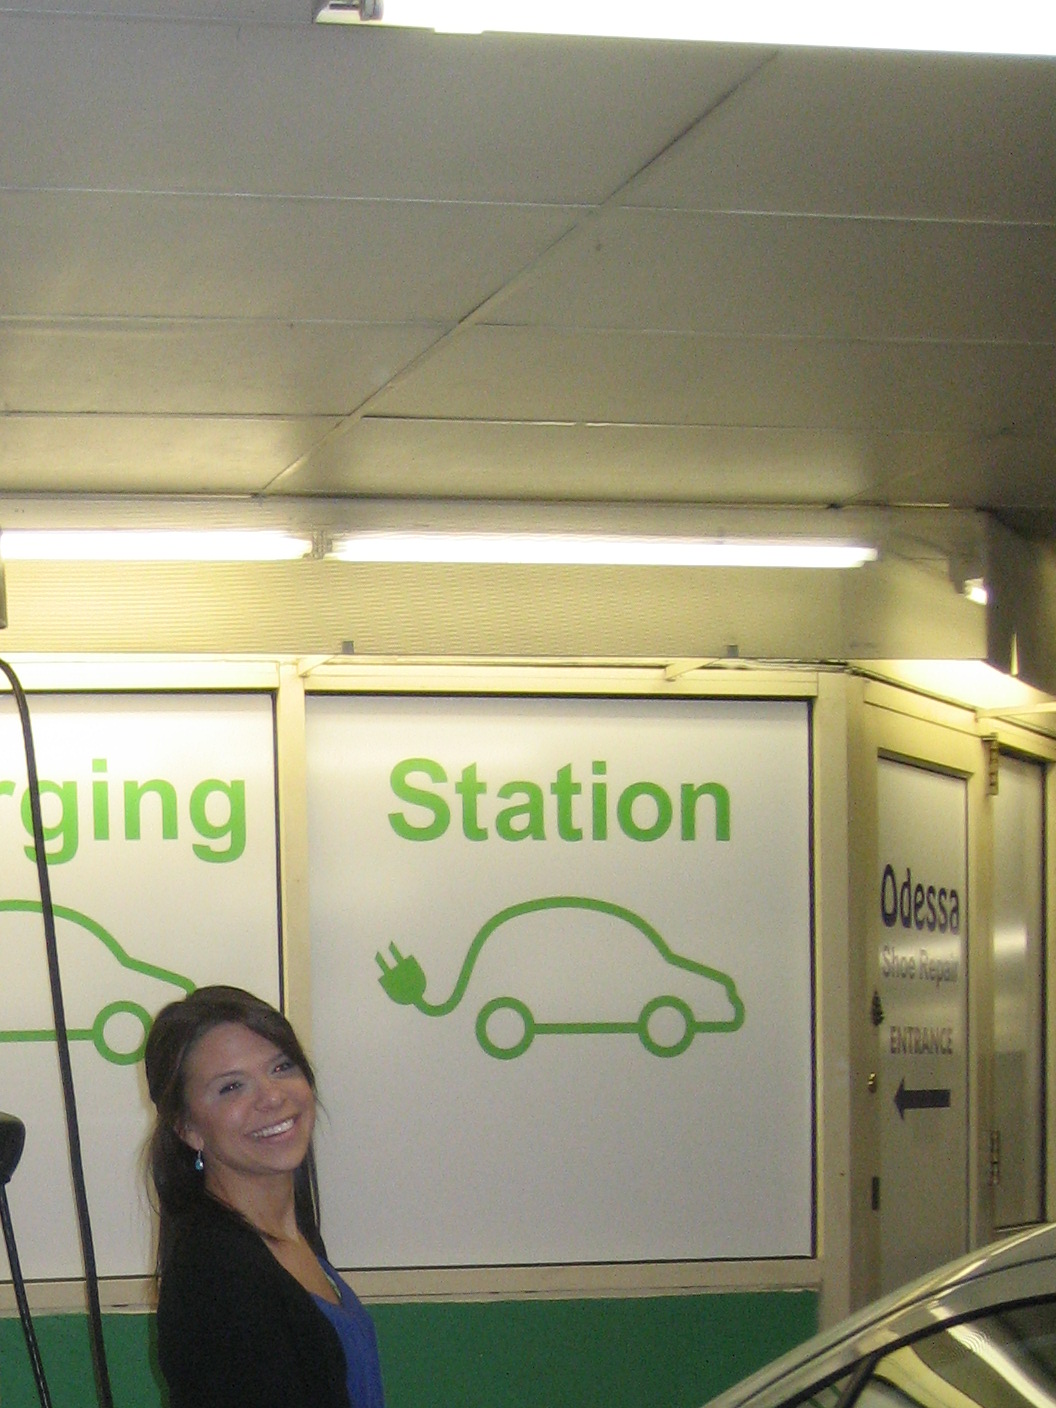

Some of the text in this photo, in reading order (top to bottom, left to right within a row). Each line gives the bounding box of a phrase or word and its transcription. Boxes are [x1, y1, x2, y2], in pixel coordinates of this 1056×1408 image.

[388, 757, 731, 842] Station
[881, 864, 959, 934] Odessa
[882, 945, 915, 979] Shoe
[890, 1026, 953, 1055] ENTRANCE
